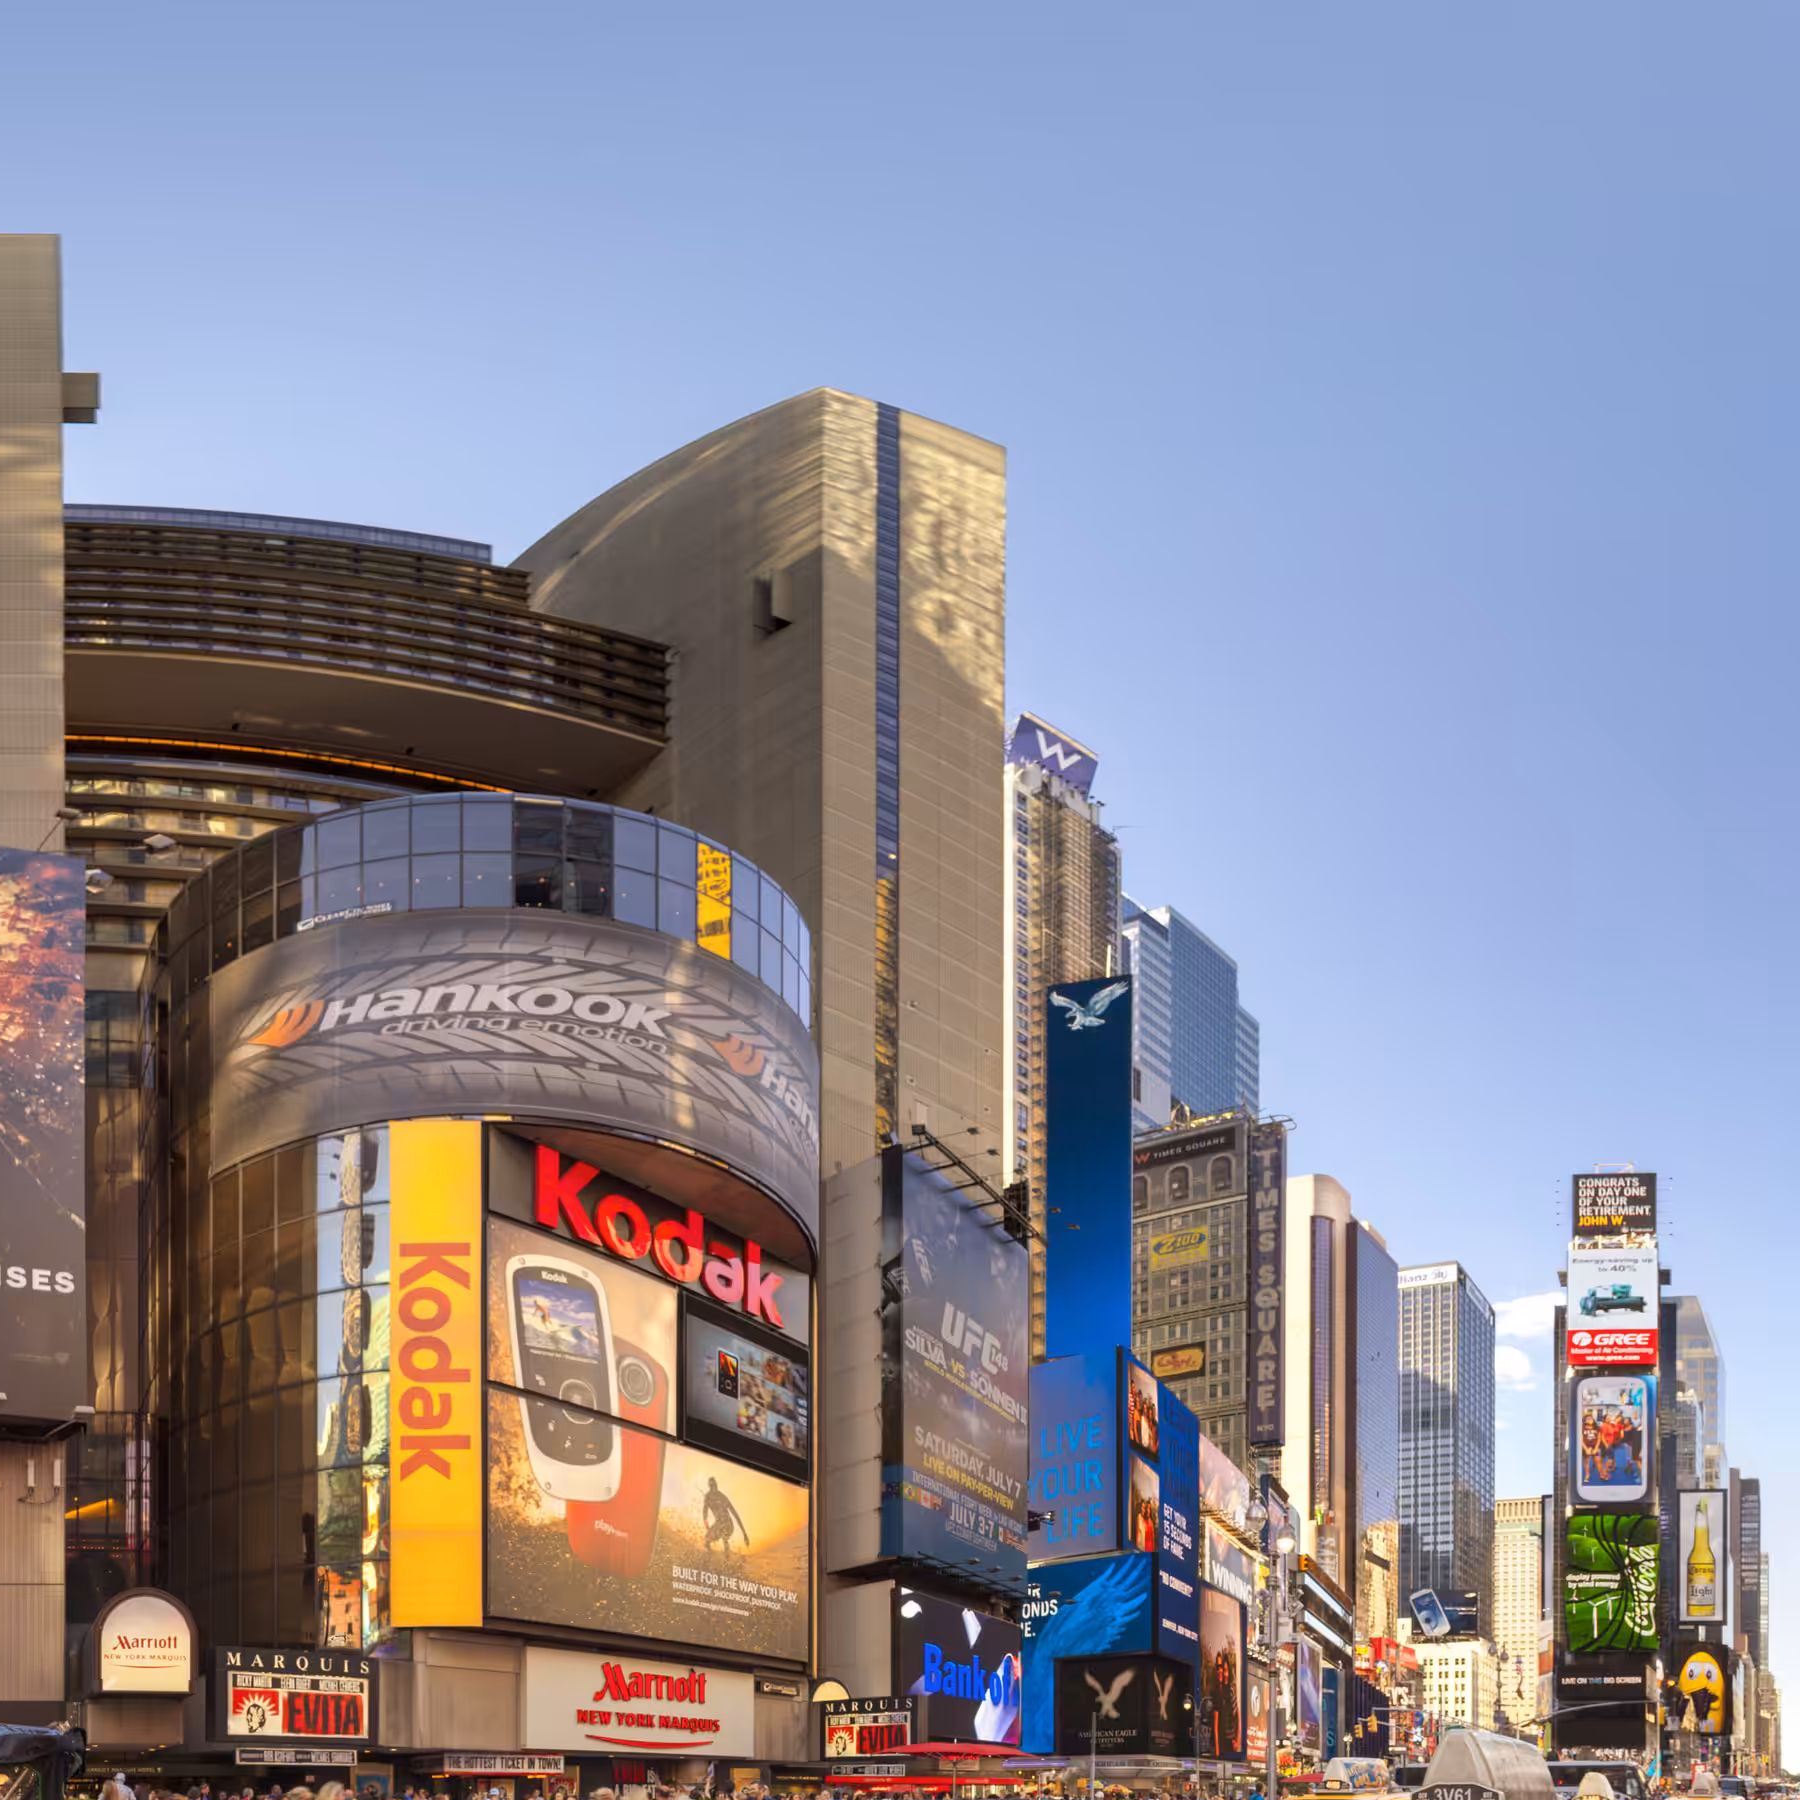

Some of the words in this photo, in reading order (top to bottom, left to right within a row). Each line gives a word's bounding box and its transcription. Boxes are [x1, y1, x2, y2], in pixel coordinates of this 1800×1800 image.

[1035, 729, 1082, 772] W
[379, 1010, 511, 1041] driving
[519, 1016, 668, 1056] emotion
[1255, 1147, 1280, 1253] TIMES
[1578, 1177, 1641, 1188] CONGRATS
[1578, 1187, 1595, 1197] ON
[1598, 1187, 1621, 1197] DAY
[1623, 1186, 1647, 1197] ONE
[1578, 1196, 1594, 1206] OF
[1596, 1196, 1628, 1206] YOUR
[534, 1143, 785, 1330] Kodak
[1578, 1216, 1609, 1226] JOHN
[1610, 1216, 1627, 1226] W.
[541, 1269, 569, 1285] Kodak
[1255, 1263, 1281, 1412] SQUARE
[1593, 1333, 1651, 1346] GREE
[398, 1241, 472, 1482] Kodak
[1041, 1416, 1101, 1459] LIVE
[914, 1425, 984, 1480] SATURDAY,
[985, 1462, 1014, 1493] JULY
[1015, 1482, 1023, 1499] 7
[1028, 1459, 1102, 1505] YOUR
[1047, 1501, 1102, 1545] LIFE
[672, 1565, 699, 1582] BUILT
[700, 1570, 718, 1584] FOR
[719, 1575, 738, 1589] THE
[738, 1578, 761, 1595] WAY
[760, 1584, 777, 1598] YOU
[778, 1587, 799, 1604] PLAY.
[113, 1633, 179, 1651] Marriott
[227, 1651, 370, 1674] MARQUIS
[593, 1658, 708, 1705] Marriott
[923, 1642, 988, 1700] Bank
[989, 1676, 1018, 1707] of
[288, 1690, 361, 1735] EVITA
[576, 1707, 614, 1729] NEW
[616, 1709, 657, 1731] YORK
[659, 1712, 721, 1733] MARQUIS
[826, 1698, 914, 1713] MARQUIS
[448, 1755, 463, 1769] THE
[464, 1755, 495, 1770] HOTTEST
[498, 1756, 526, 1770] TICKET
[526, 1756, 536, 1770] IN
[537, 1756, 562, 1771] TOWN!
